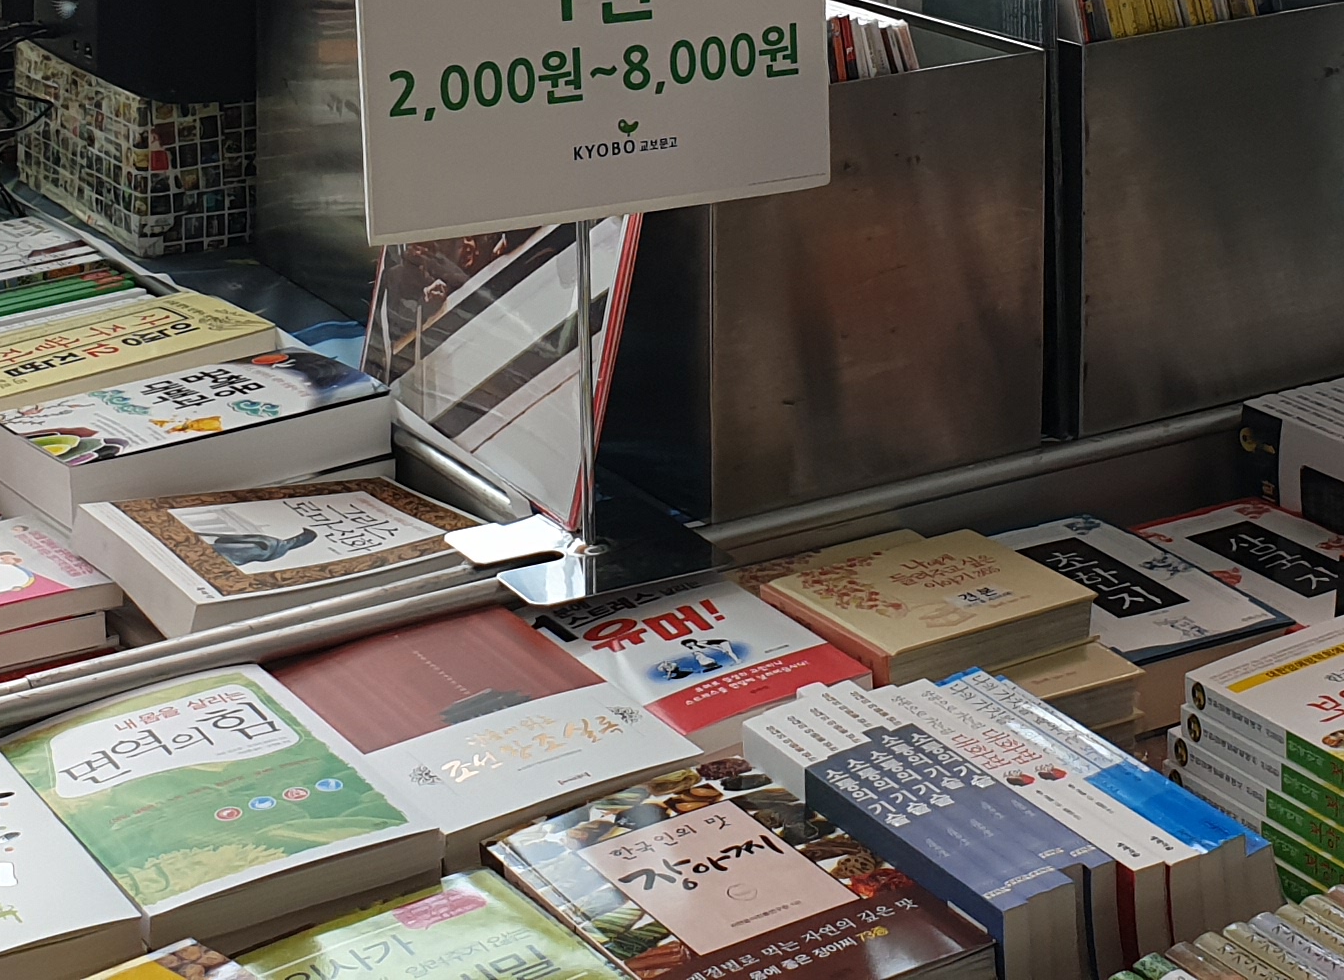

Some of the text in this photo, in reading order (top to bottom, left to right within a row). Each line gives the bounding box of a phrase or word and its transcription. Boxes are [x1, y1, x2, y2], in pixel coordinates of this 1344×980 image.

[387, 22, 801, 122] 2,000원~8,000원
[573, 134, 678, 162] KYOBO 교보문고
[1229, 533, 1340, 591] 삼국지
[581, 598, 727, 654] 유머!
[114, 717, 138, 732] 내
[186, 691, 247, 711] 살리는
[58, 702, 281, 784] 면역의 힘
[951, 732, 1012, 771] 대화법
[981, 727, 1044, 766] 대화법
[912, 781, 955, 808] 기술
[923, 764, 965, 790] 기술
[953, 762, 997, 789] 기술
[867, 800, 912, 828] 기술
[889, 789, 932, 817] 기술
[609, 813, 732, 861] 한국인의 맛
[617, 834, 785, 891] 장아찌
[761, 938, 801, 963] 먹는
[800, 916, 857, 950] 자연의
[857, 904, 896, 924] 깊은
[894, 897, 919, 912] 맛
[812, 934, 857, 965] 장아찌
[405, 939, 489, 979] 알려주지
